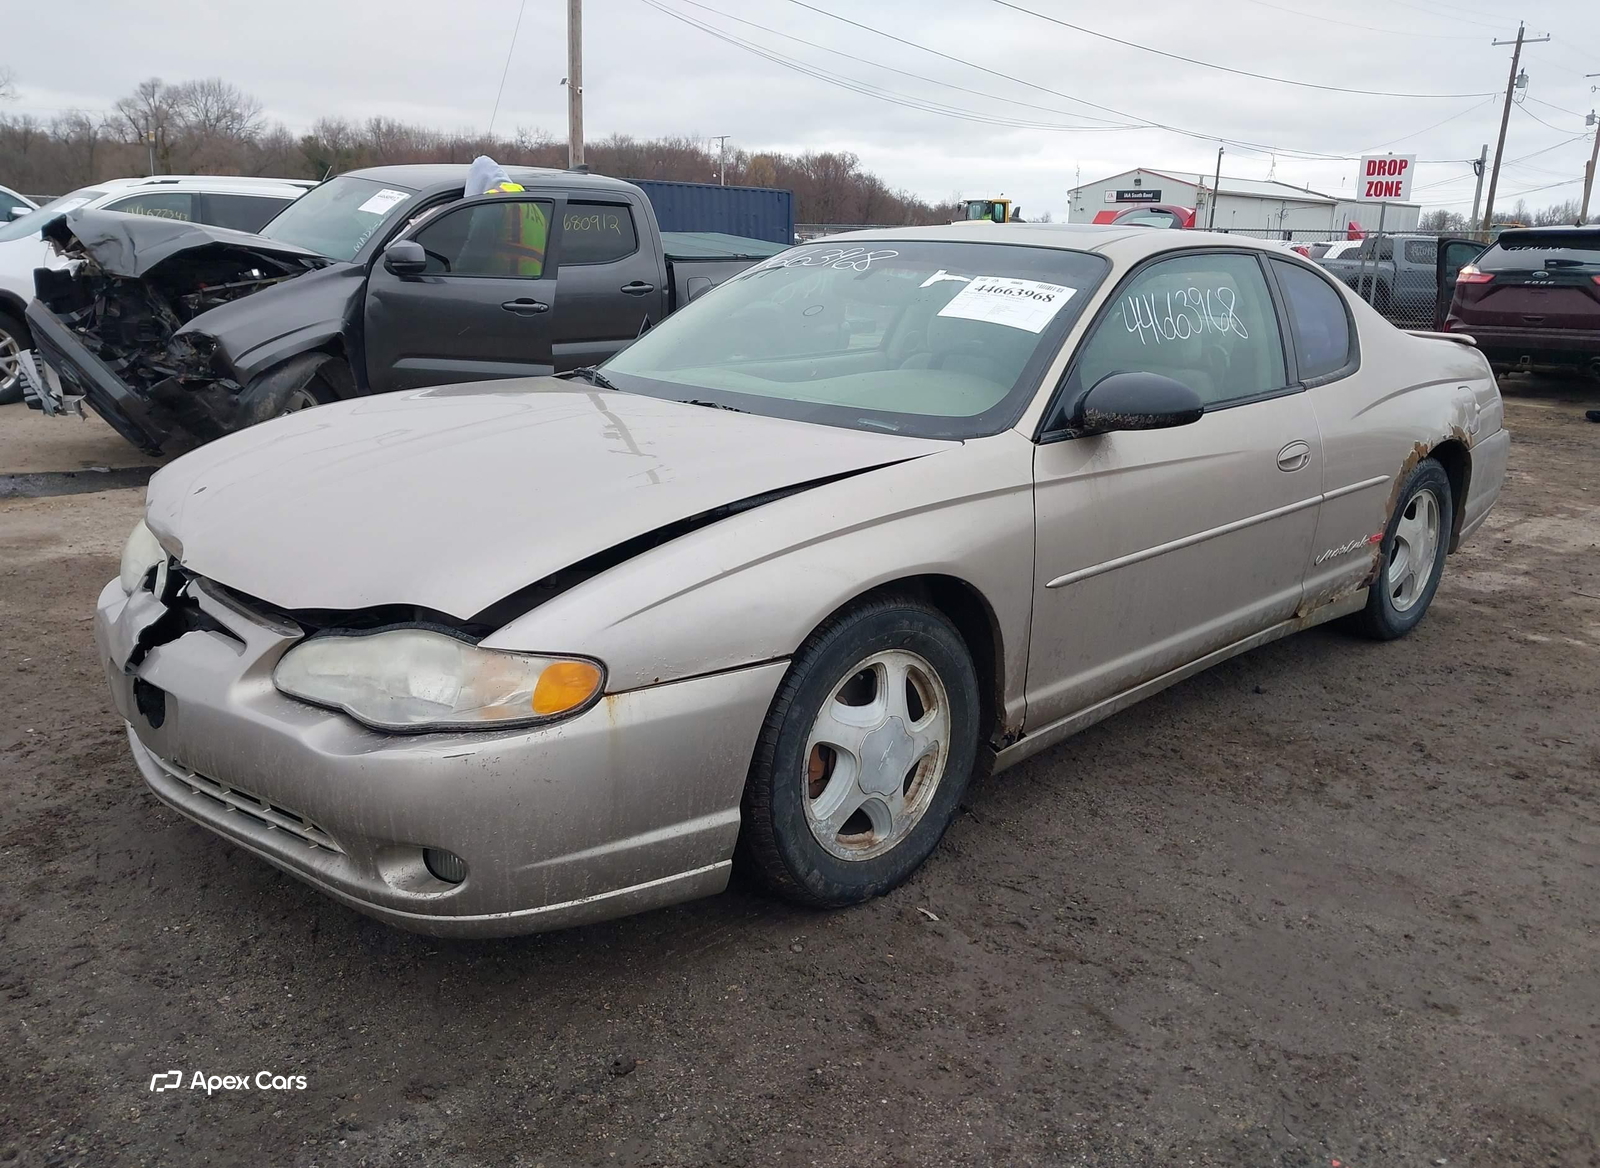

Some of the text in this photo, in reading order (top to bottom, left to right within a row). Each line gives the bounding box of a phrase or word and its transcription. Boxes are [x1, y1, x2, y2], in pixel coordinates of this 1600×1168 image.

[1366, 159, 1408, 176] DROP
[1365, 180, 1402, 197] ZONE
[563, 213, 621, 235] 680912
[975, 284, 1055, 303] 44663968
[1121, 286, 1249, 345] 44663968
